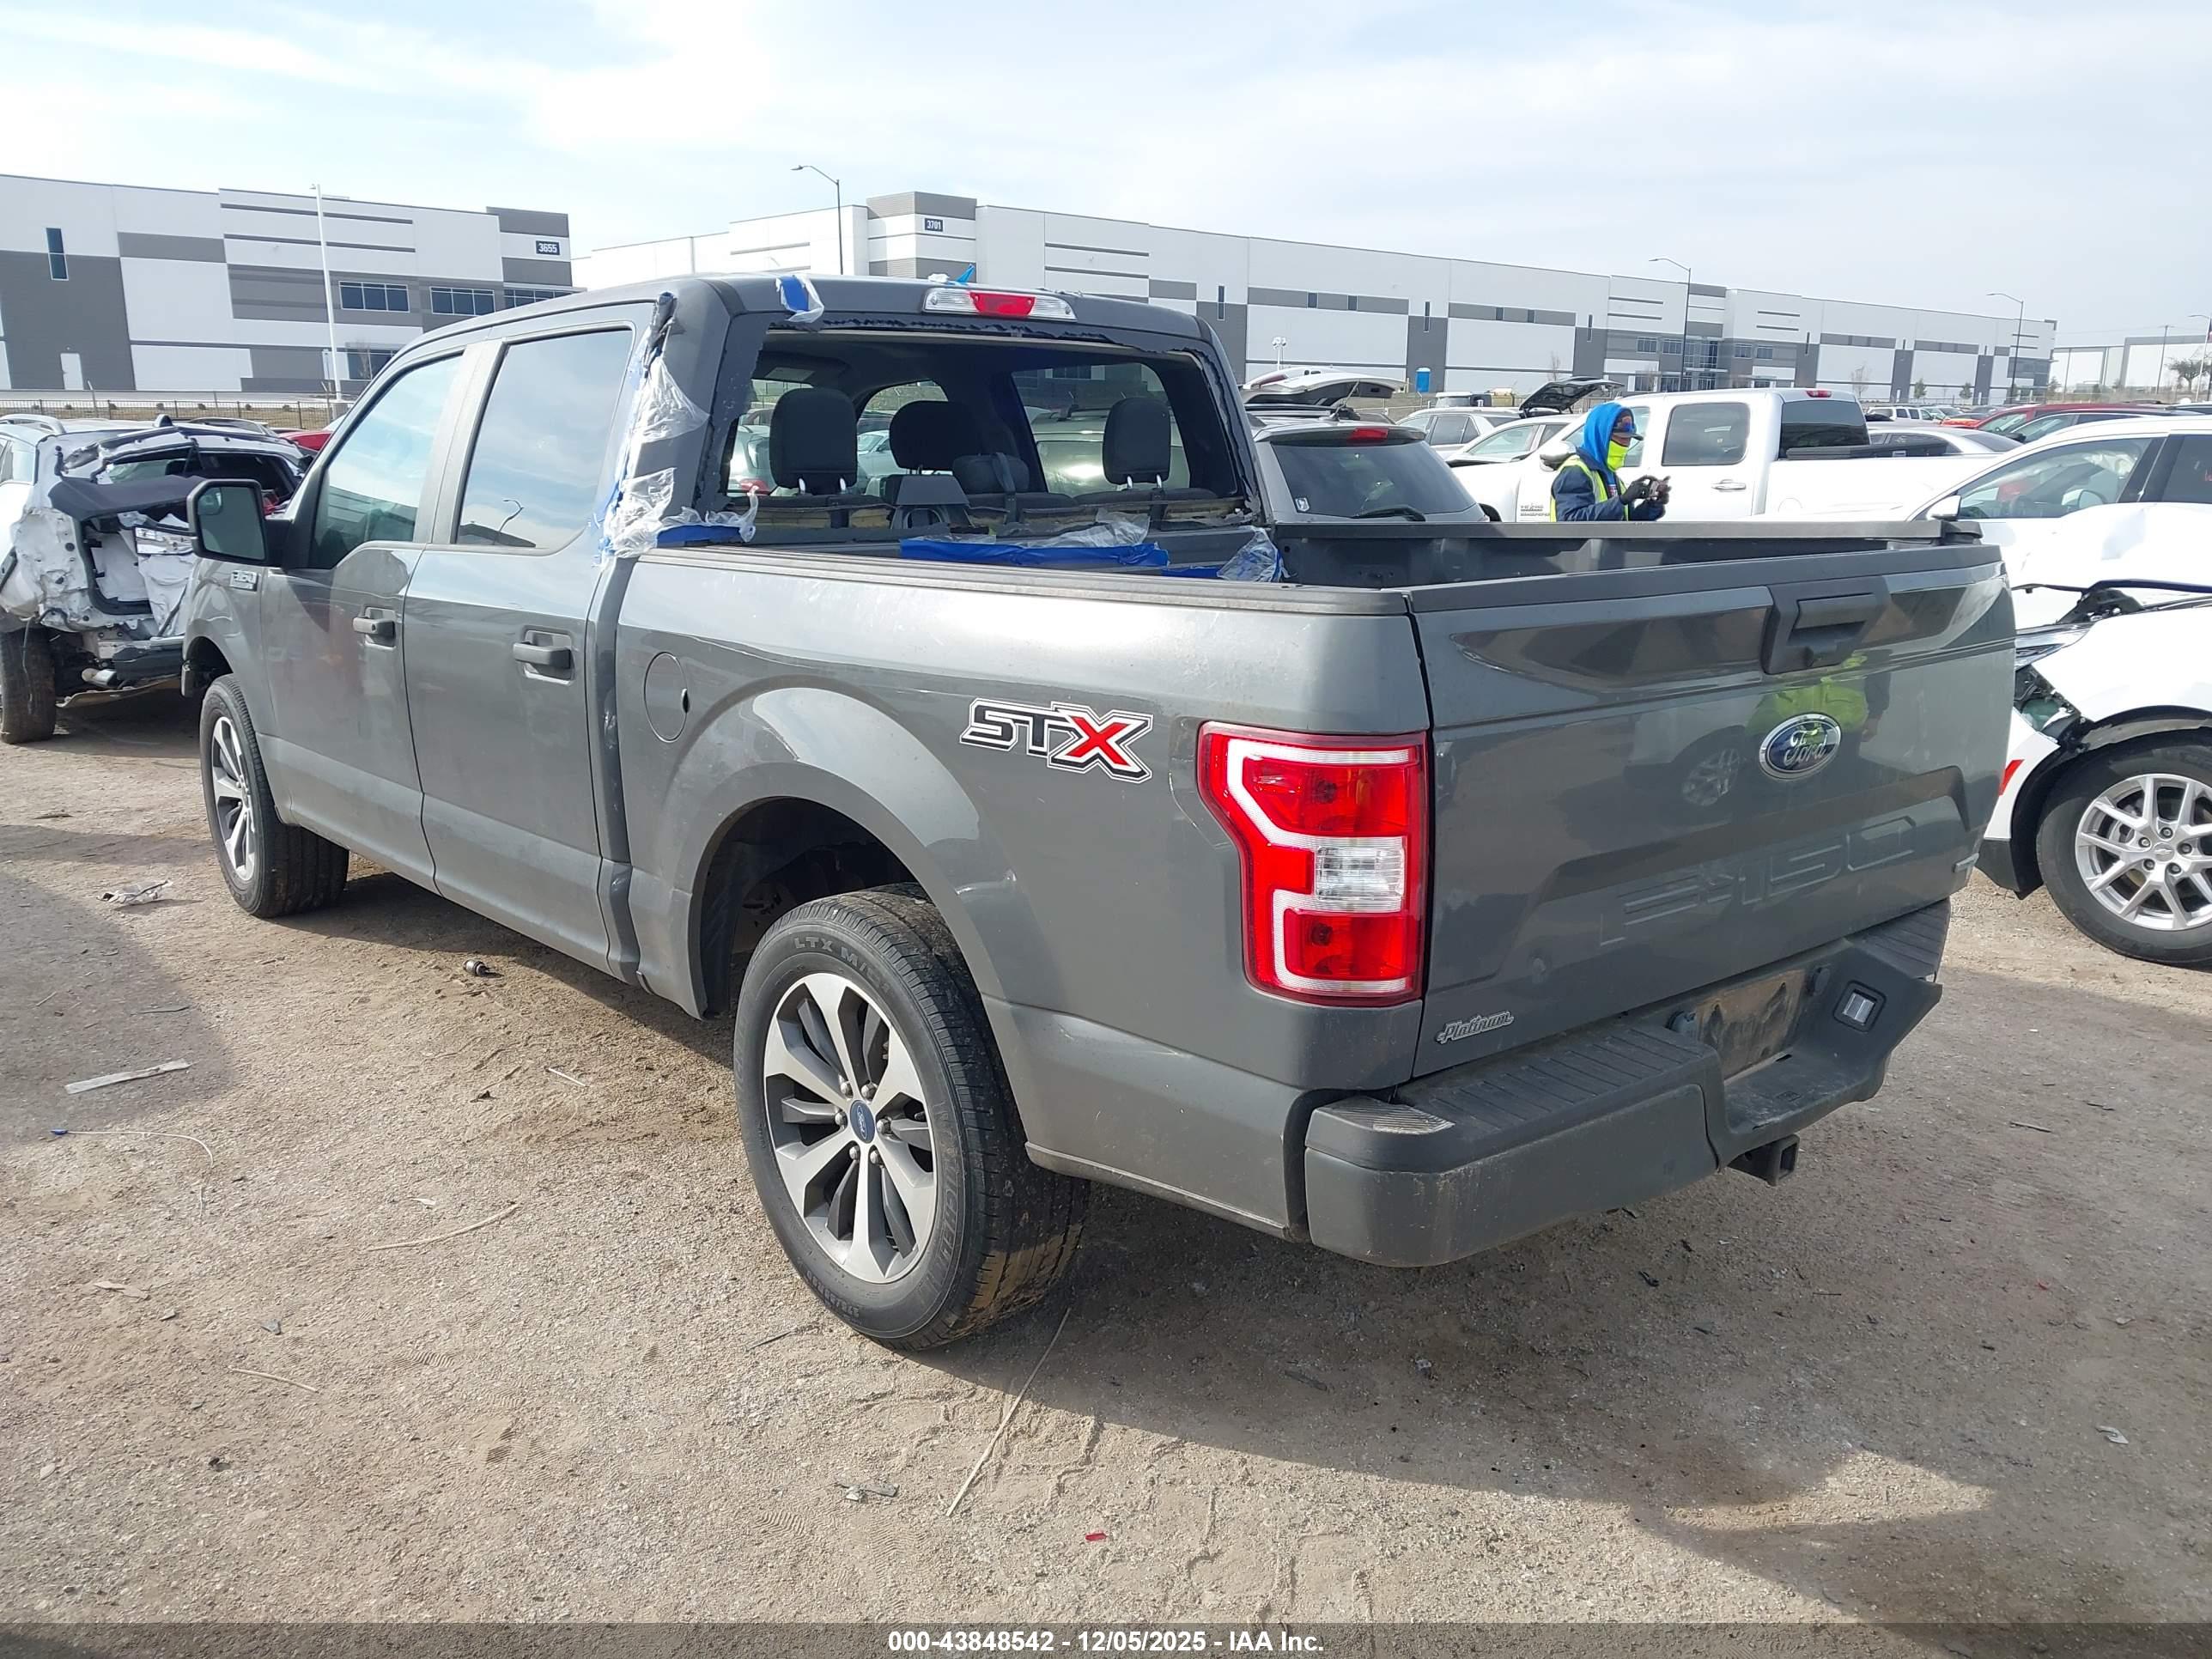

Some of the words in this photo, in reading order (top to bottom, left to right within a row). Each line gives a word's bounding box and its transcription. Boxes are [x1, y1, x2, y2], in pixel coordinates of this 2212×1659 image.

[927, 220, 941, 230] 3701
[538, 242, 557, 253] 3655
[959, 697, 1154, 784] STX
[1784, 728, 1828, 766] Ford
[793, 936, 833, 952] LTX
[1437, 1011, 1515, 1044] Platinum
